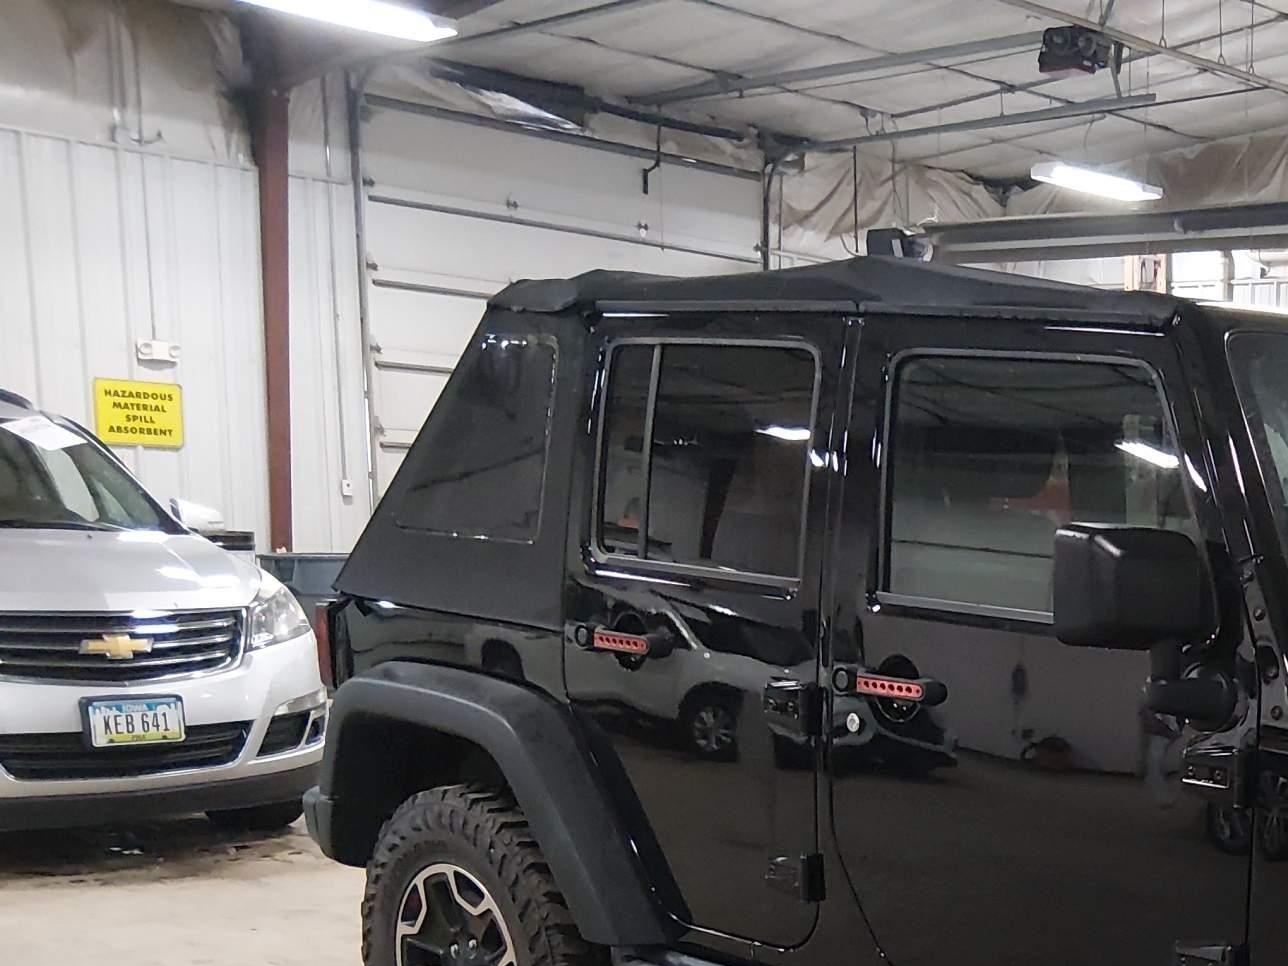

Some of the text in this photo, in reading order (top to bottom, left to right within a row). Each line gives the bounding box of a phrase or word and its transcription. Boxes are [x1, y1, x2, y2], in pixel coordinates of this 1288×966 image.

[104, 389, 173, 401] HAZARDOUS
[112, 401, 167, 413] MATERIAL
[125, 414, 156, 424] SPILL
[108, 425, 173, 437] ABSORBENT
[103, 712, 170, 736] KEB 641
